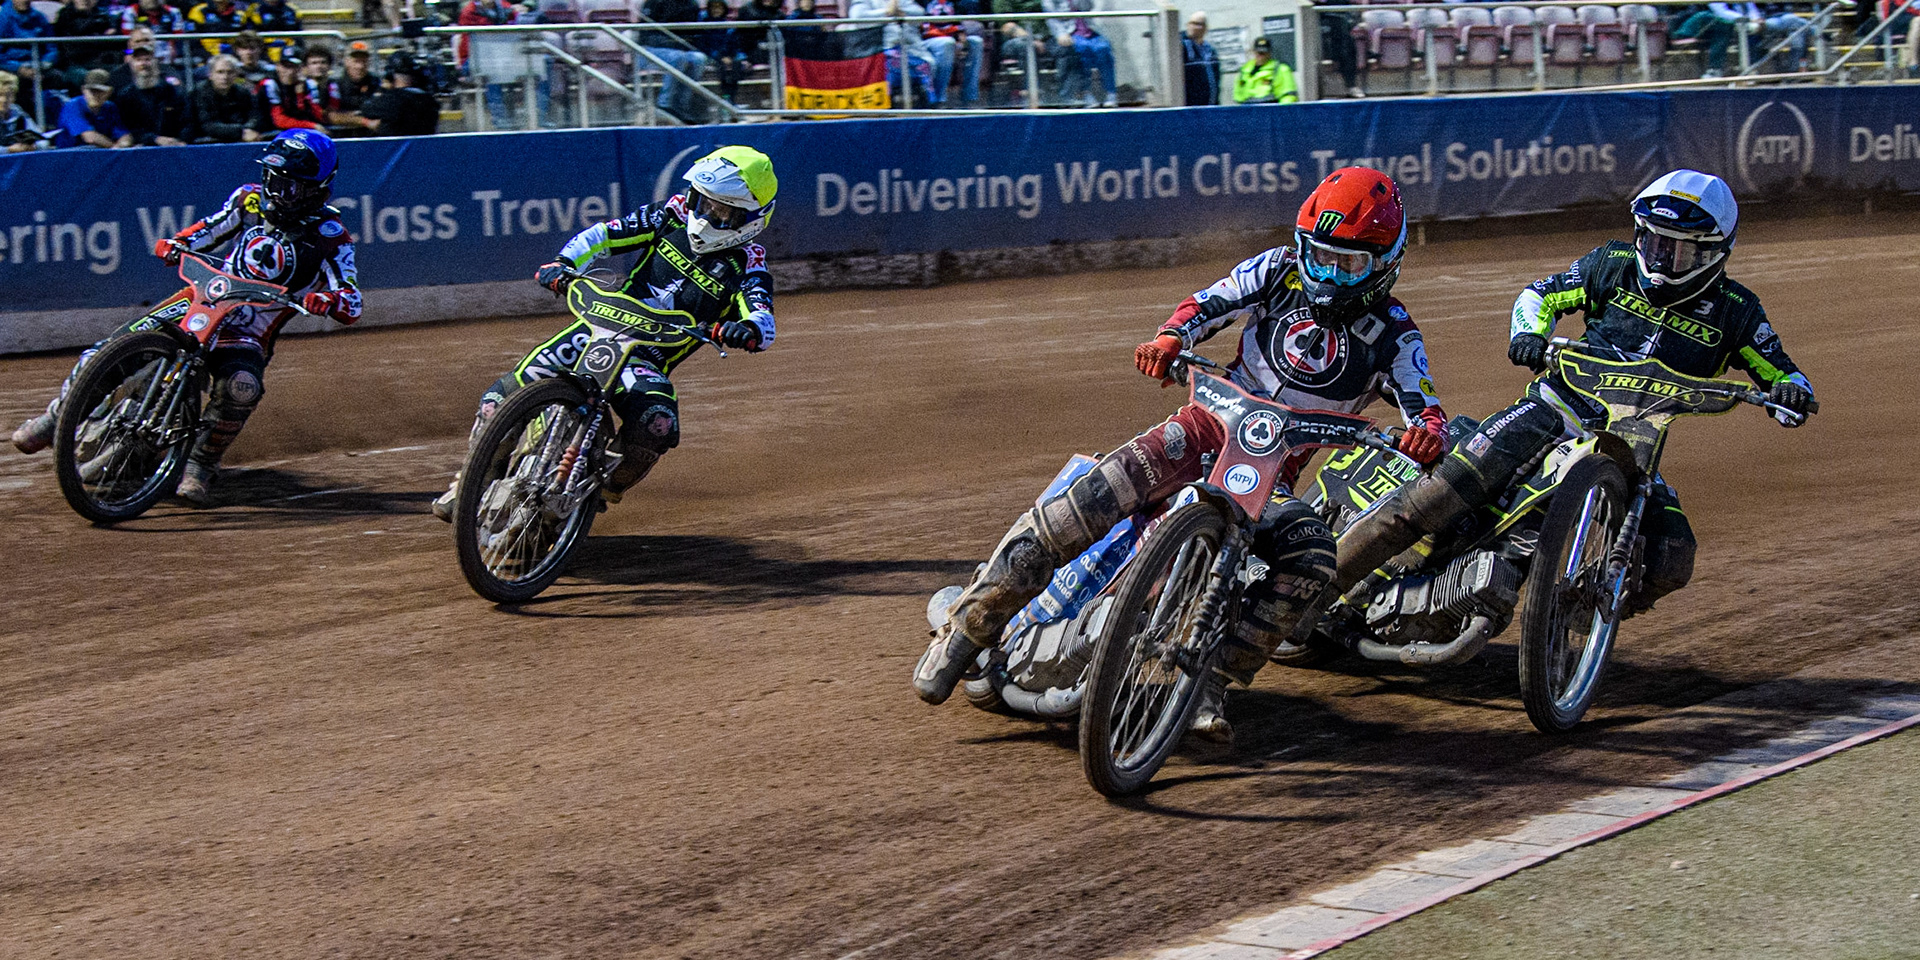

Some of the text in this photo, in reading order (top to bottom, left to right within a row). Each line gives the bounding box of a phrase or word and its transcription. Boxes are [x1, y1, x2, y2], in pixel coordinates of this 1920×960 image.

[1750, 135, 1800, 164] ATPI
[815, 165, 1042, 218] Delivering
[1055, 155, 1180, 203] World
[1192, 153, 1298, 196] Class
[1446, 136, 1617, 182] Solutions
[471, 182, 621, 236] Travel
[661, 243, 723, 295] TRU MIX
[592, 303, 619, 318] TRU
[1286, 311, 1312, 324] BELL
[1620, 293, 1715, 342] TRU MIX
[1694, 299, 1714, 315] 3
[1604, 375, 1648, 389] TRU
[1128, 441, 1158, 486] automax
[1328, 446, 1365, 471] 3
[1229, 472, 1253, 485] ATPI
